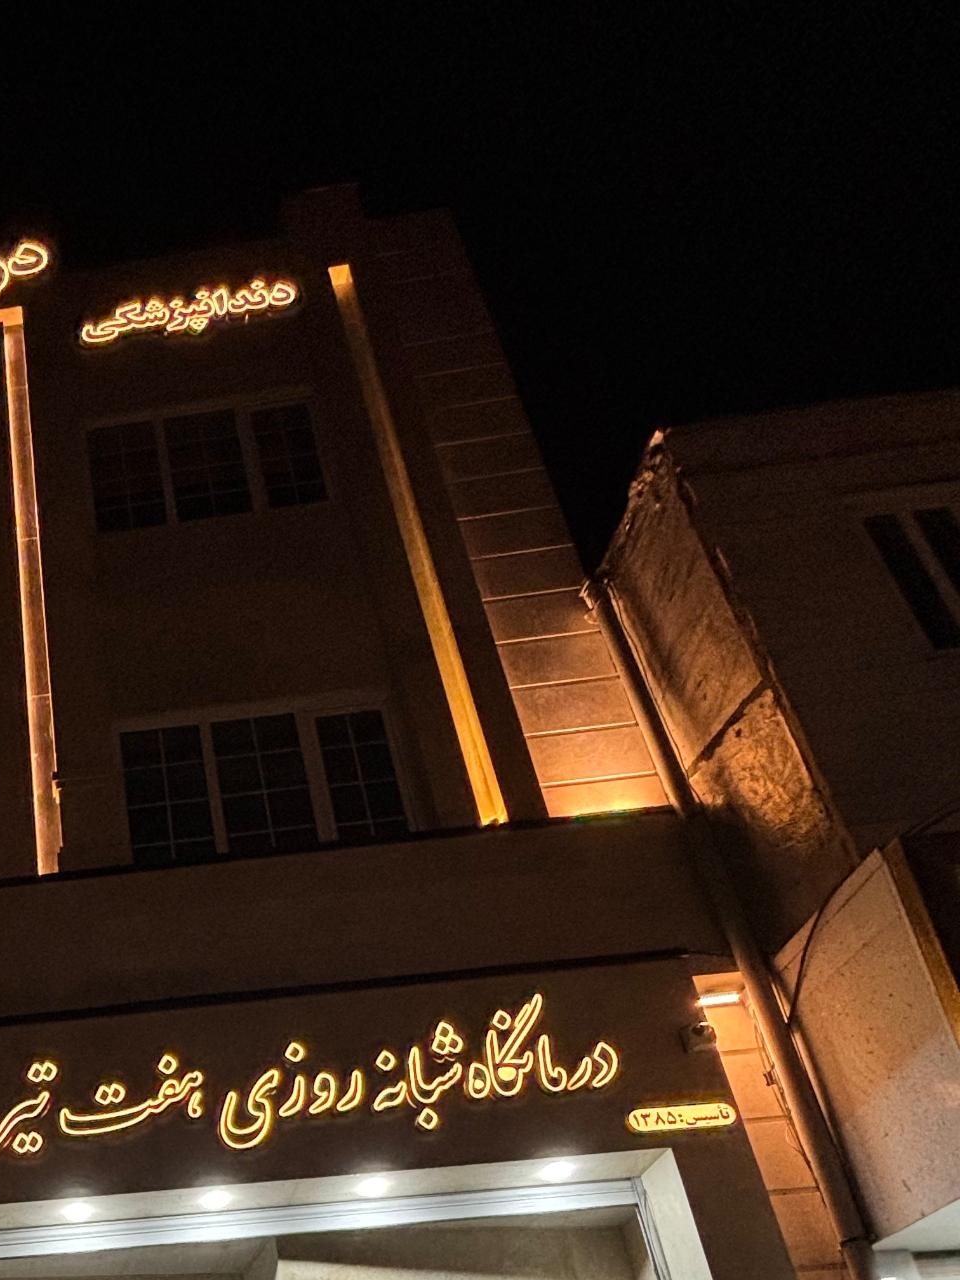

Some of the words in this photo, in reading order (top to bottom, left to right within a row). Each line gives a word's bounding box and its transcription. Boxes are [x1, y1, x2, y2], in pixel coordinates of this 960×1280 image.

[80, 278, 297, 343] دندانپزشکی
[465, 993, 619, 1099] درمانگاه
[58, 1053, 205, 1136] هفت
